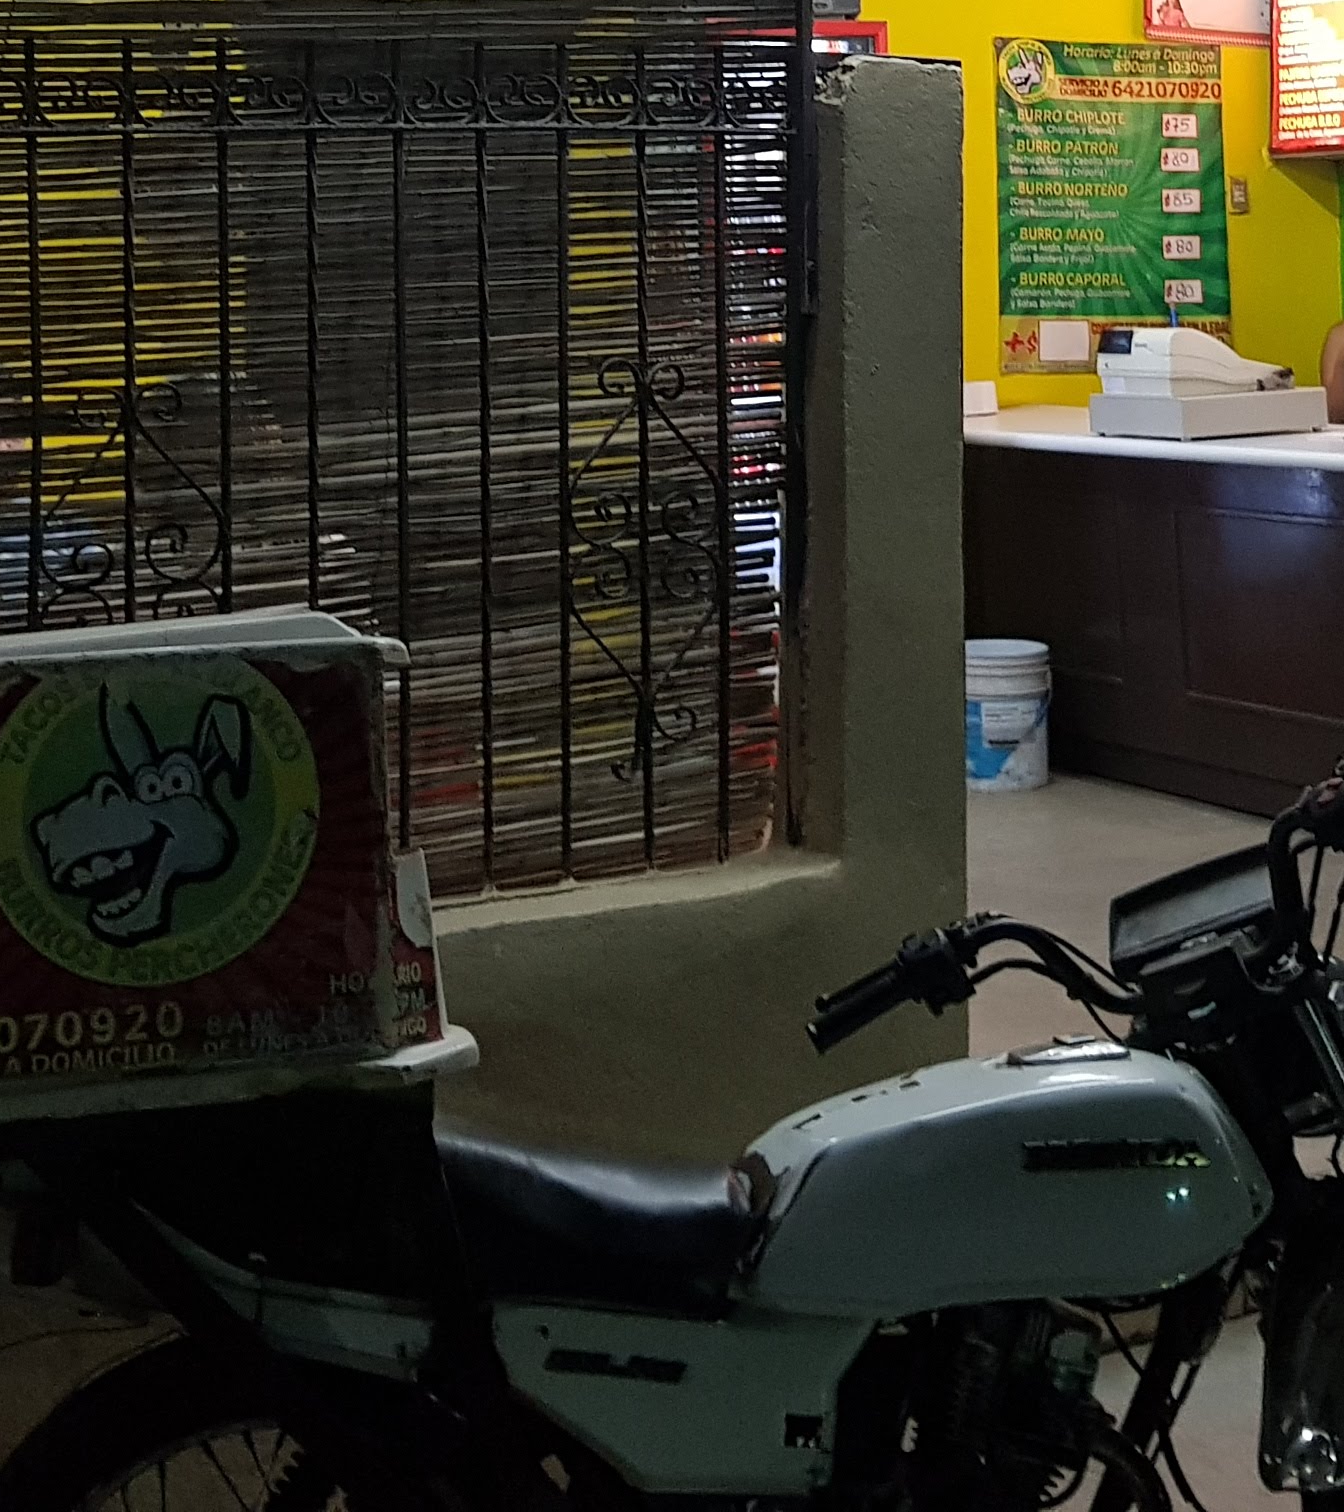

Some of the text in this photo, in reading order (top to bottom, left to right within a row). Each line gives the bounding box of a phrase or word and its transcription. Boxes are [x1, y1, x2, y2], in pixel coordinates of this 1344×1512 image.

[1117, 47, 1151, 60] Lunes
[1163, 48, 1215, 64] Domingo
[1167, 60, 1217, 76] 10:30pm
[1112, 80, 1221, 99] 6421070920
[1017, 108, 1126, 125] BURRO CHIPLOTE
[1017, 139, 1062, 154] BURRO
[1018, 180, 1062, 196] BURRO
[1019, 226, 1105, 242] BURRO MAYO
[1019, 271, 1126, 286] BURRO CAPORAL
[31, 1041, 176, 1074] DOMICILIO
